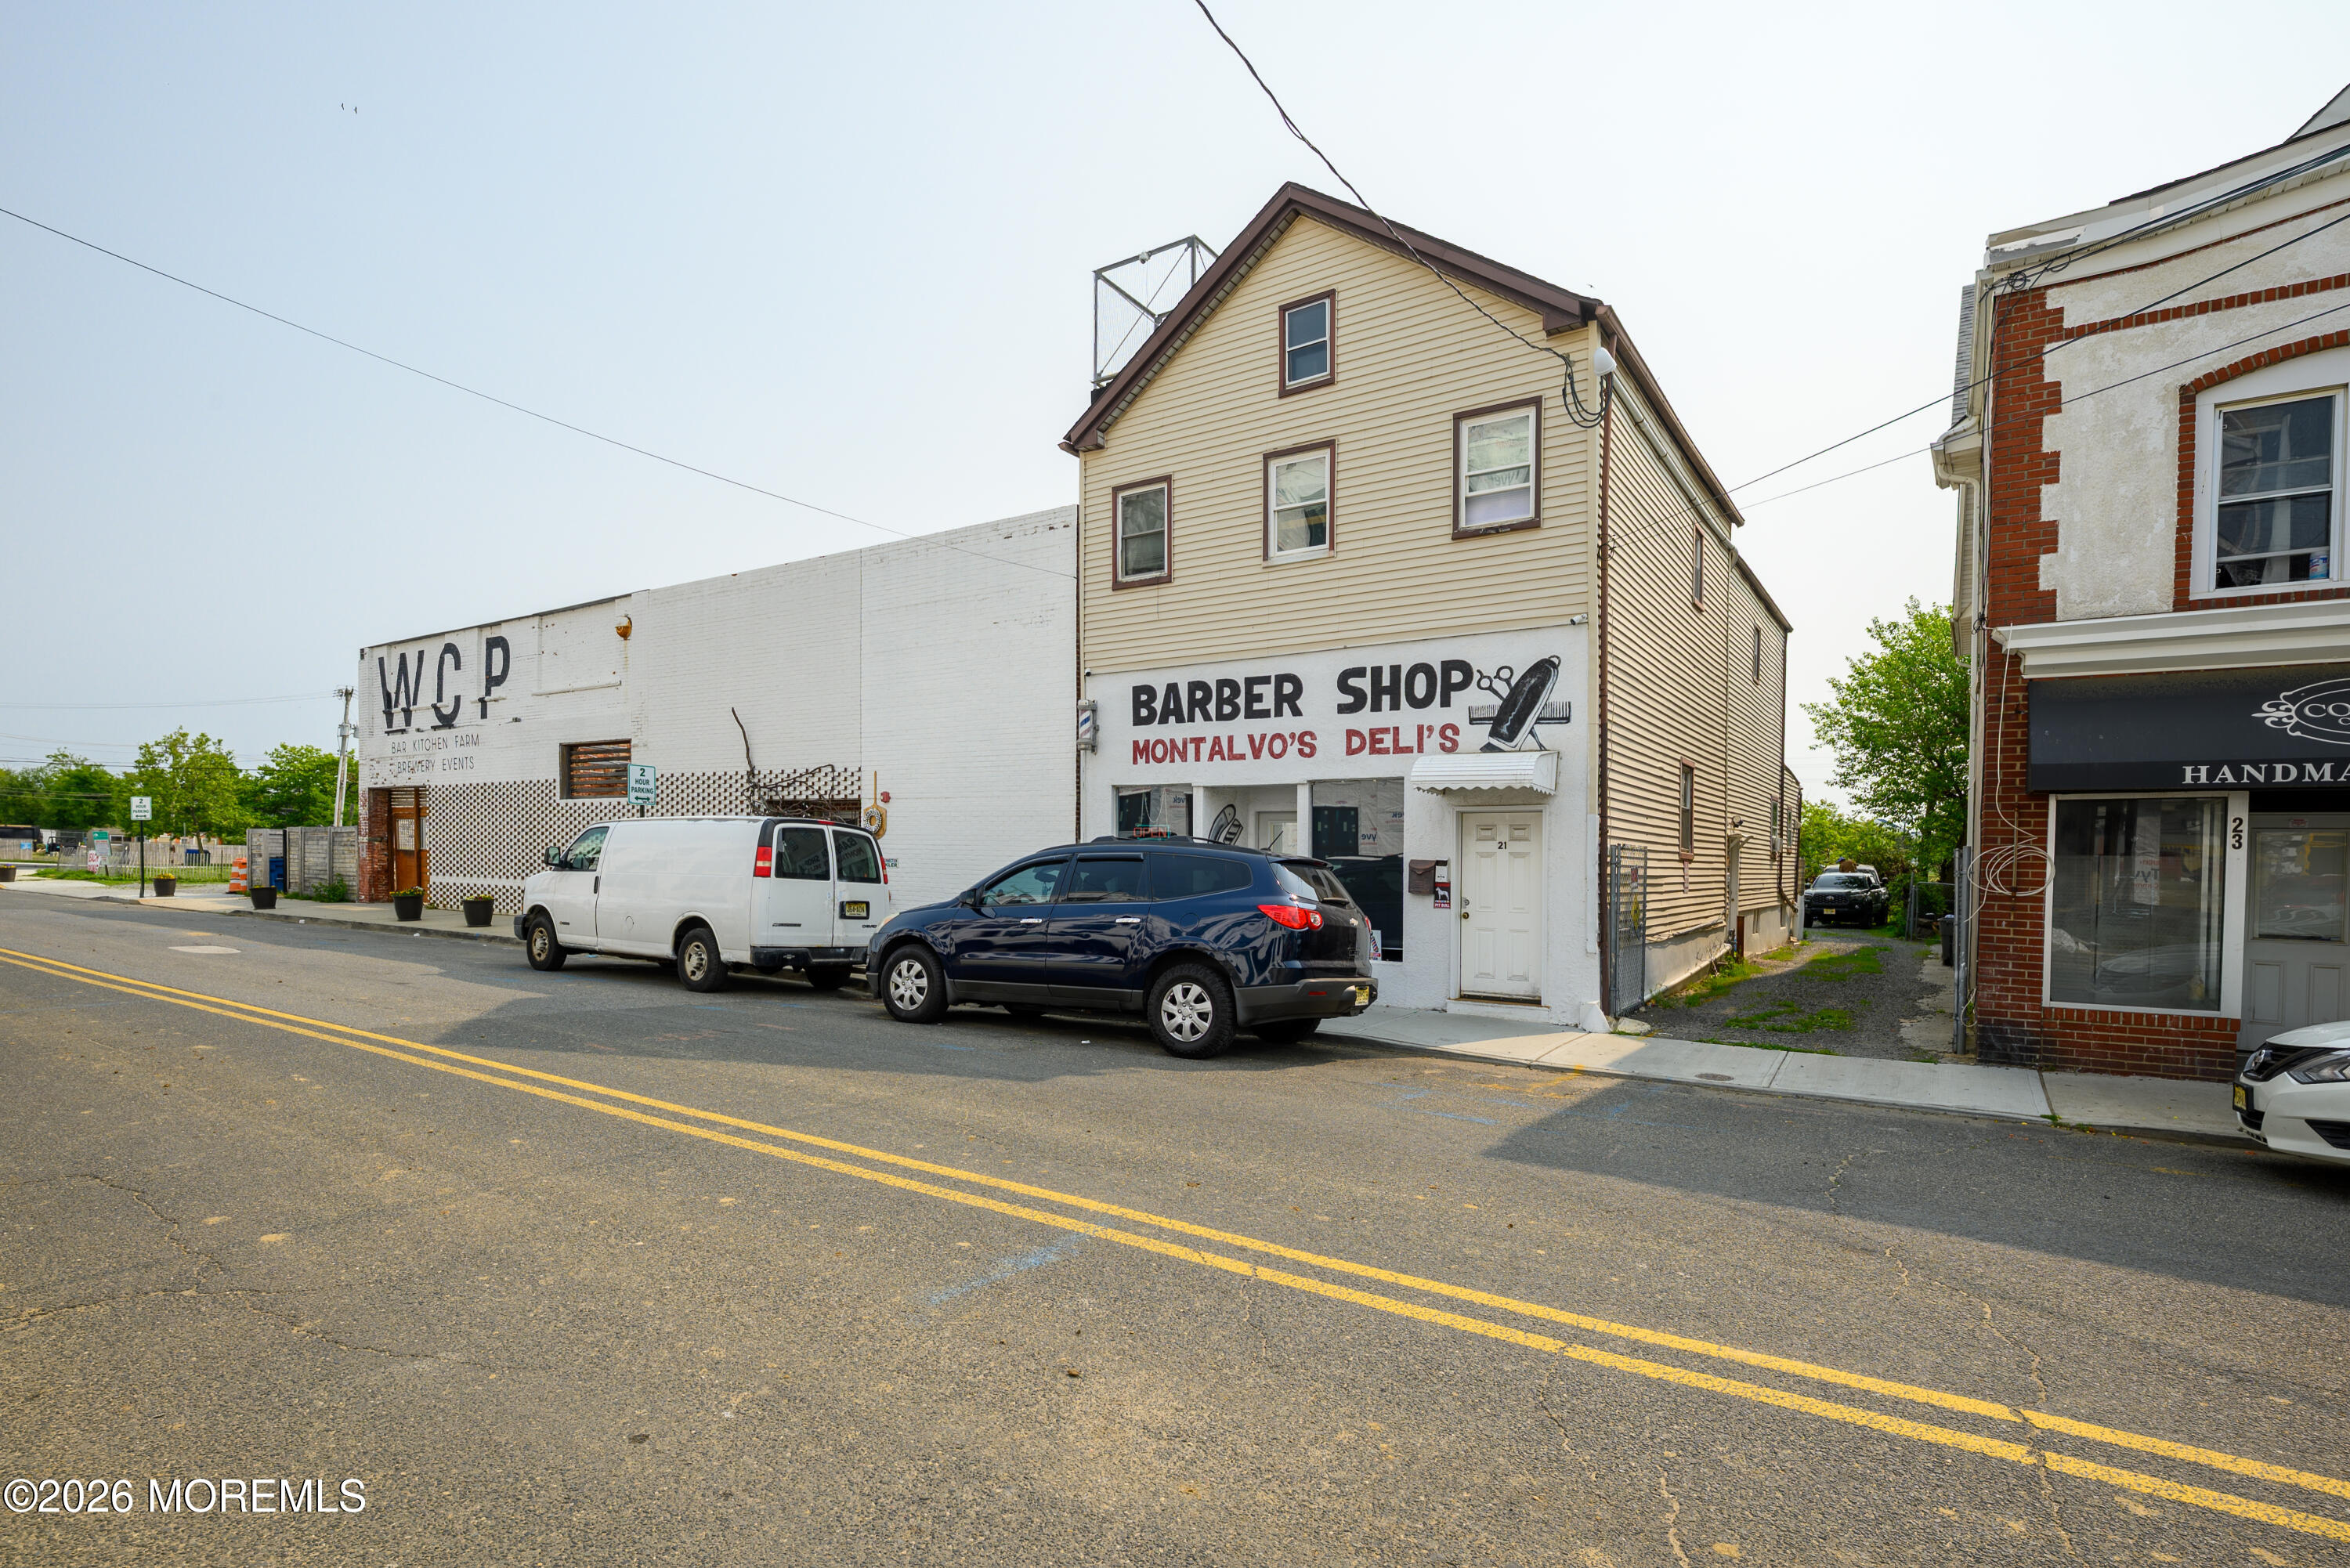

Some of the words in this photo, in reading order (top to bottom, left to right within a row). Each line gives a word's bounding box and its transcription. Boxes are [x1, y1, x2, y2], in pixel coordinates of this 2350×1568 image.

[378, 635, 510, 728] WCP
[1132, 673, 1303, 726] BARBER
[1336, 659, 1473, 714] SHOP
[392, 741, 407, 753] BAR
[413, 736, 448, 752] KITCHEN
[454, 733, 479, 748] FARM
[1132, 729, 1317, 764] MONTALVO'S
[1345, 723, 1459, 757] DELI'S
[397, 759, 436, 774] BREWERY
[442, 756, 475, 771] EVENTS
[1133, 827, 1167, 837] OPEN
[1497, 841, 1507, 850] 21
